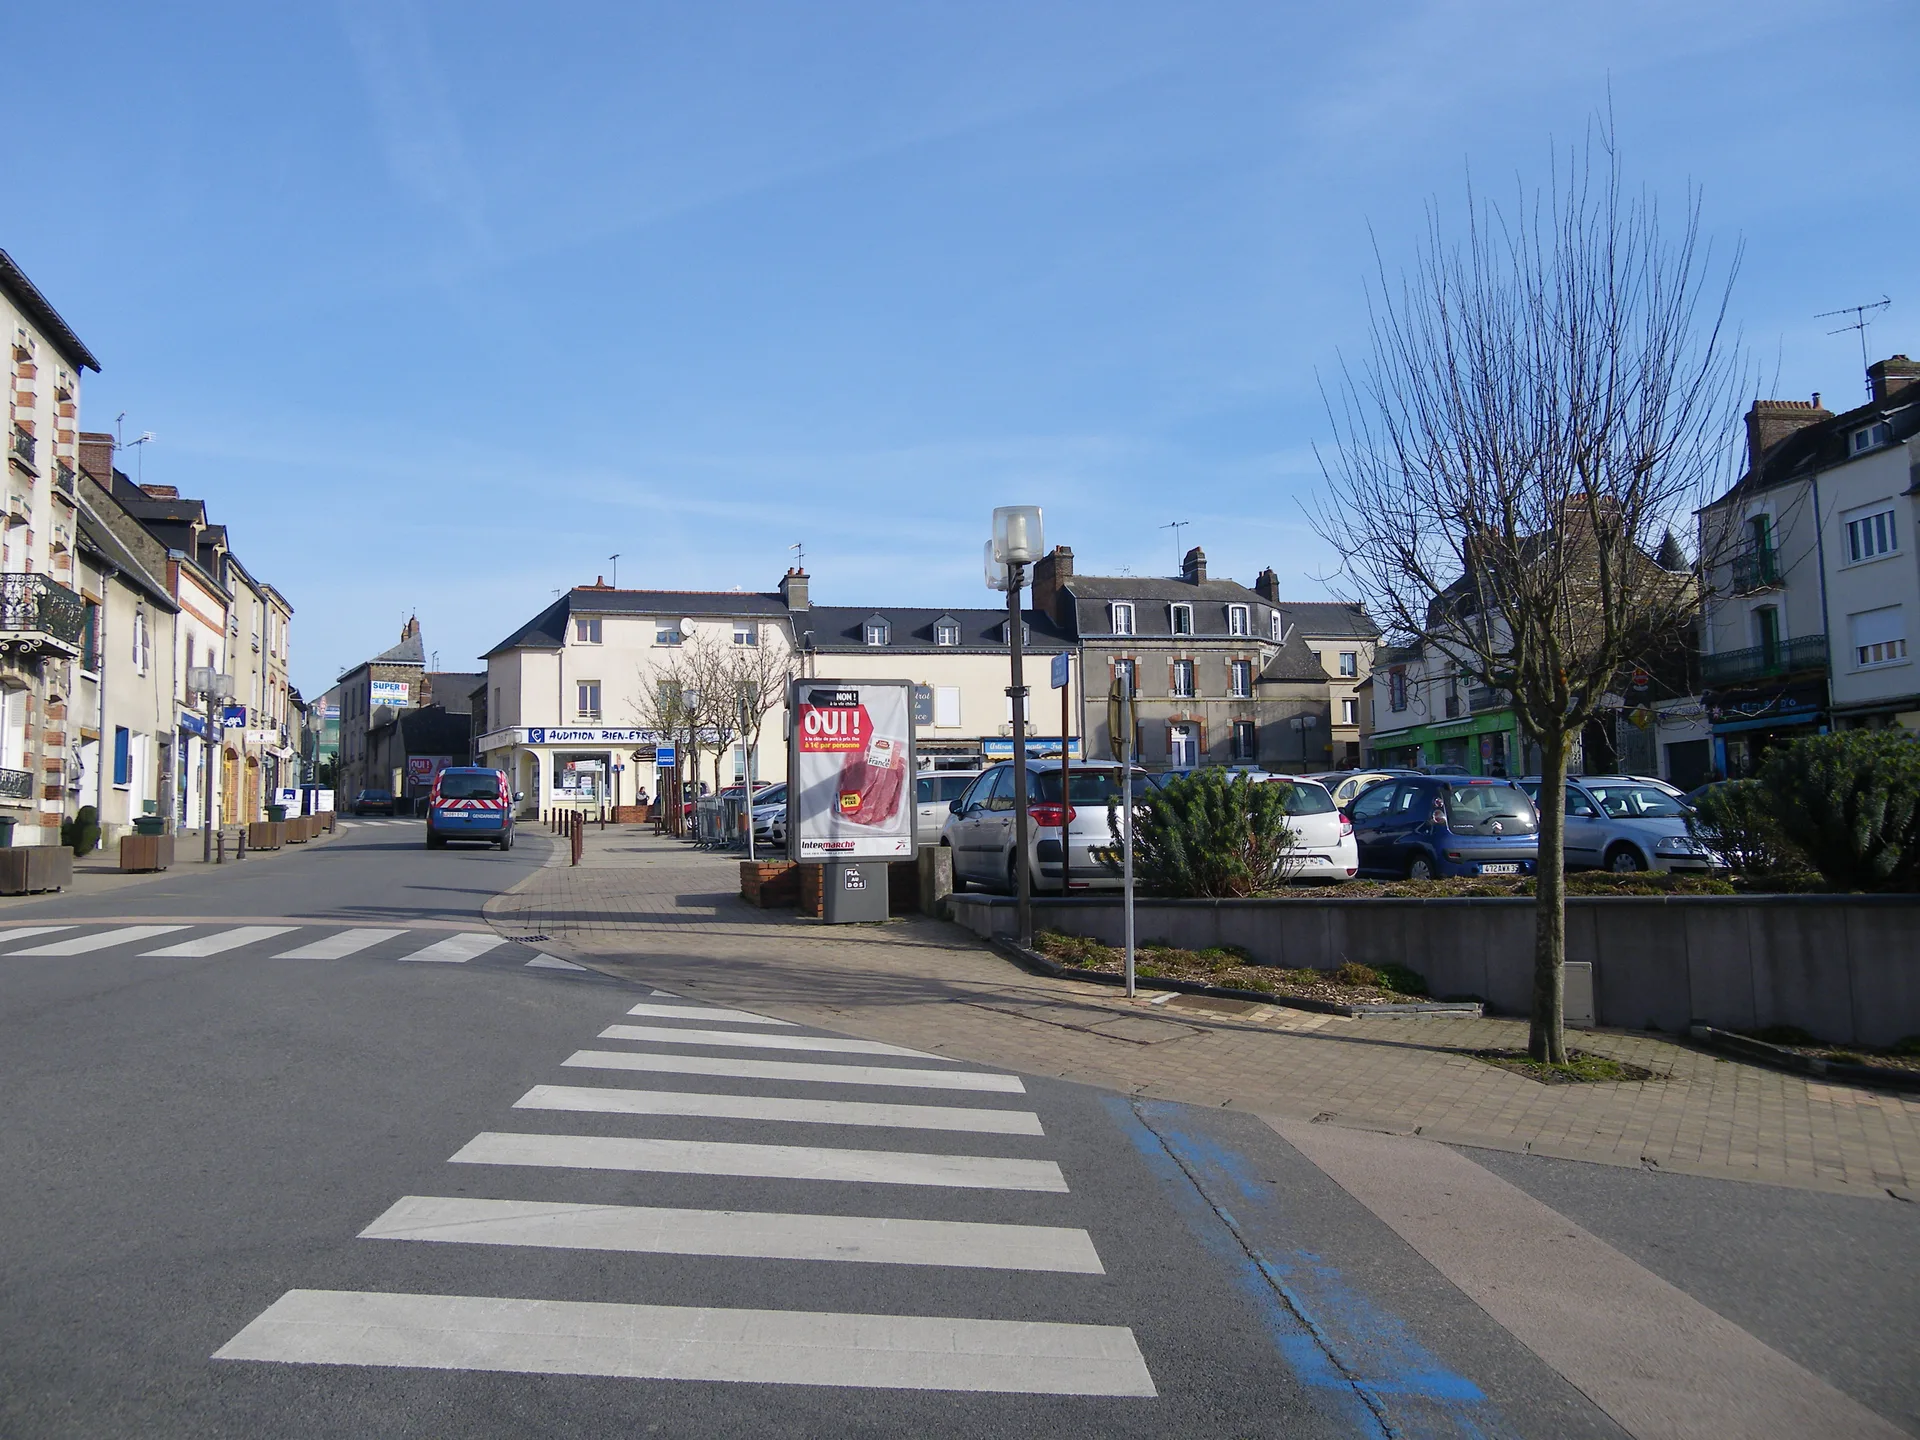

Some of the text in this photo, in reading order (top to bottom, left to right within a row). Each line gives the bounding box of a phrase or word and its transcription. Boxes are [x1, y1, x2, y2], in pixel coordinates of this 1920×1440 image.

[373, 682, 400, 690] SUPER
[836, 693, 851, 701] NON
[804, 710, 847, 735] OUI
[1435, 723, 1478, 737] PHARMACIE
[549, 731, 595, 740] AUDITION
[989, 742, 1013, 750] Artisan
[868, 757, 890, 768] France
